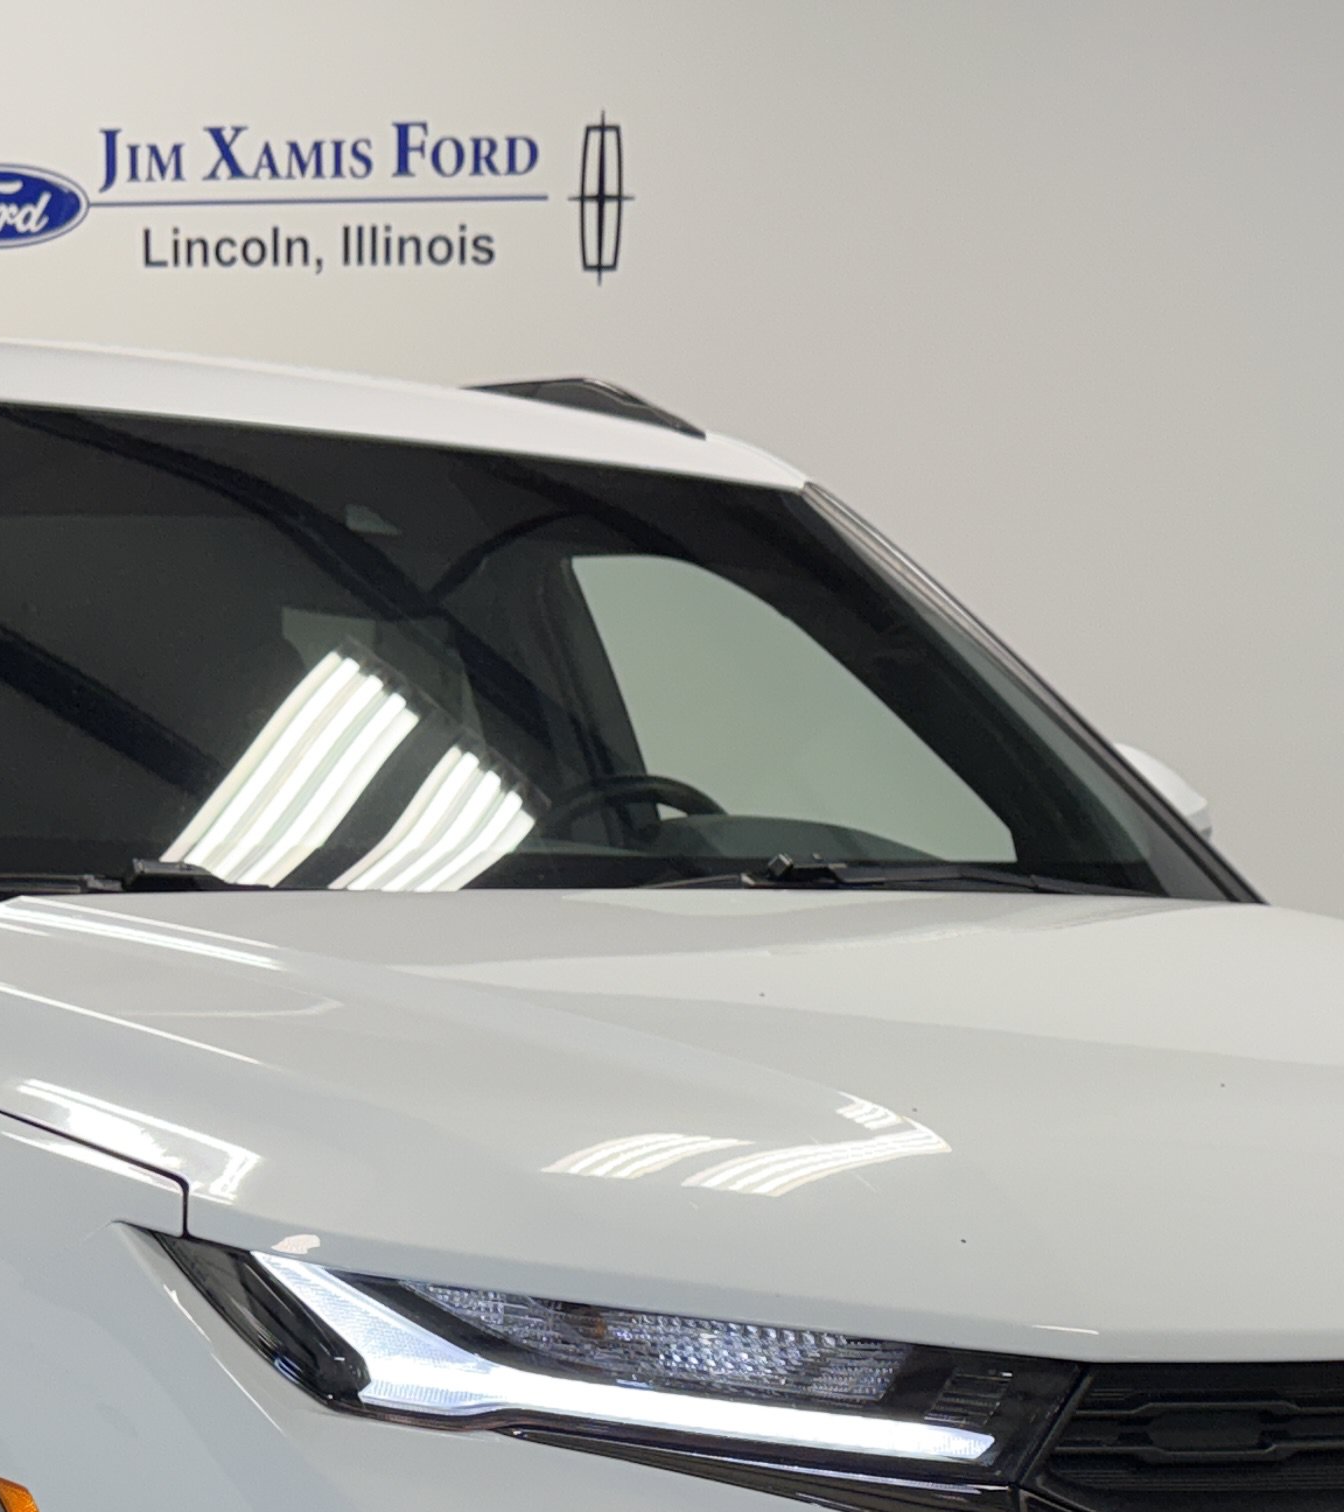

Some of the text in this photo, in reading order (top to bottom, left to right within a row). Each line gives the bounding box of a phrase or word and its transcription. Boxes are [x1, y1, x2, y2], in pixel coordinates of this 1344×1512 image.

[98, 120, 540, 194] JIM XAMIS FORD
[142, 223, 496, 275] Lincoln, Illinois
